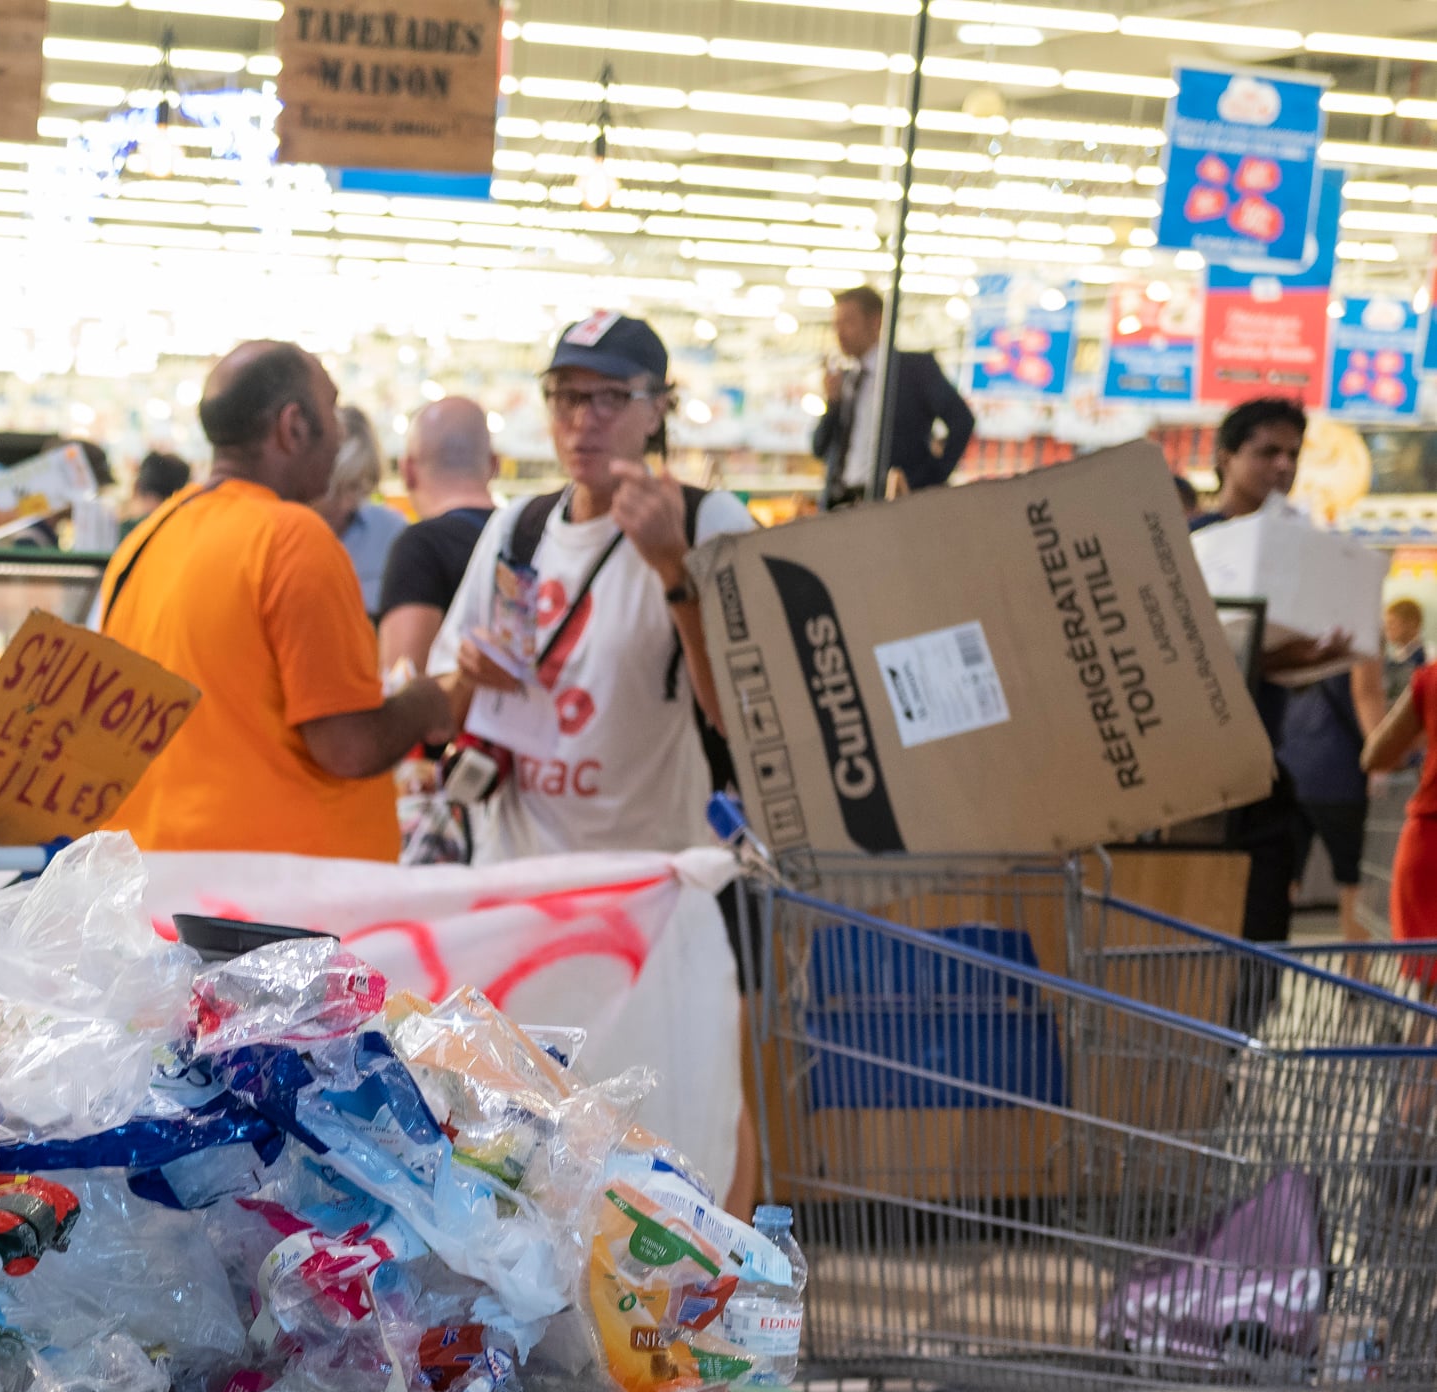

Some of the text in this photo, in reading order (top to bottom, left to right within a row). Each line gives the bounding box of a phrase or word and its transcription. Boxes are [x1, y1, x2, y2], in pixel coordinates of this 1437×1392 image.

[319, 58, 450, 98] MAISON
[2, 632, 192, 755] SAUVONS
[805, 613, 876, 799] Curtiss
[1026, 497, 1145, 790] RÉFRIGÉRATEUR
[1073, 533, 1162, 737] TOUT UTILE
